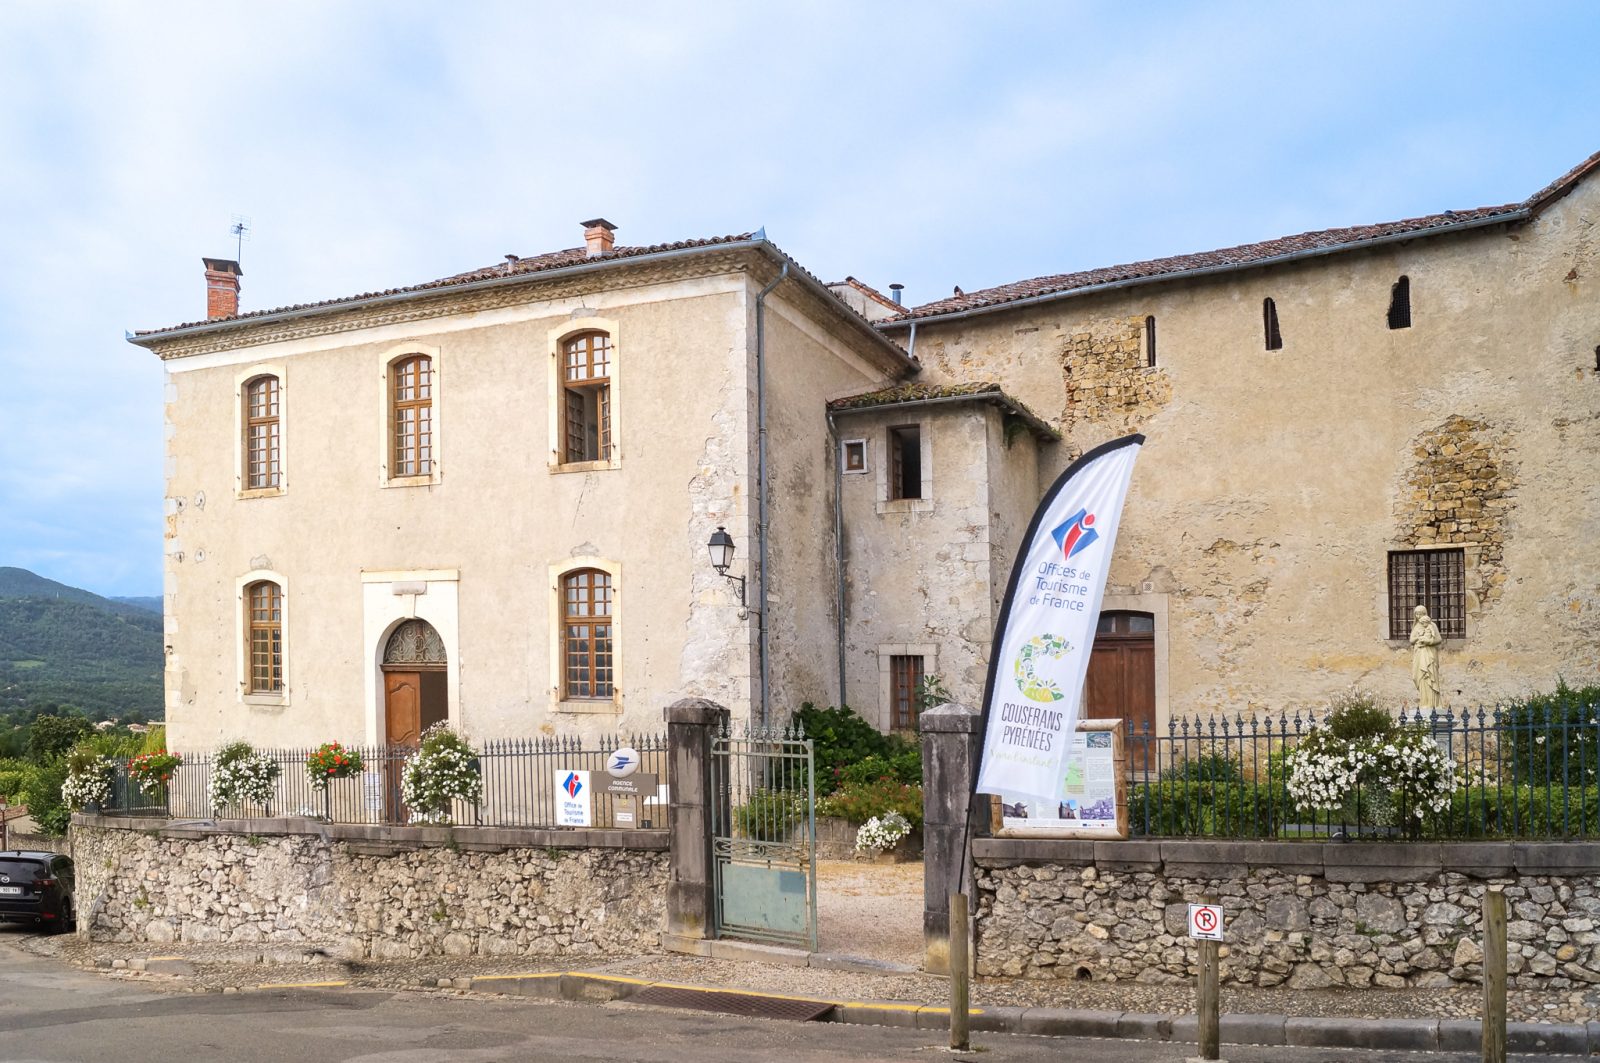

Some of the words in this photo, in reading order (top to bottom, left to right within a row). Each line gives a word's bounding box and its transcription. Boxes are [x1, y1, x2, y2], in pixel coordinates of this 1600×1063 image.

[1038, 561, 1077, 579] Offices
[1079, 570, 1091, 580] de
[1036, 576, 1088, 596] Tourisme
[1042, 593, 1085, 612] France
[1001, 702, 1063, 732] COUSERANS
[1001, 726, 1053, 752] PYRÉNÉES
